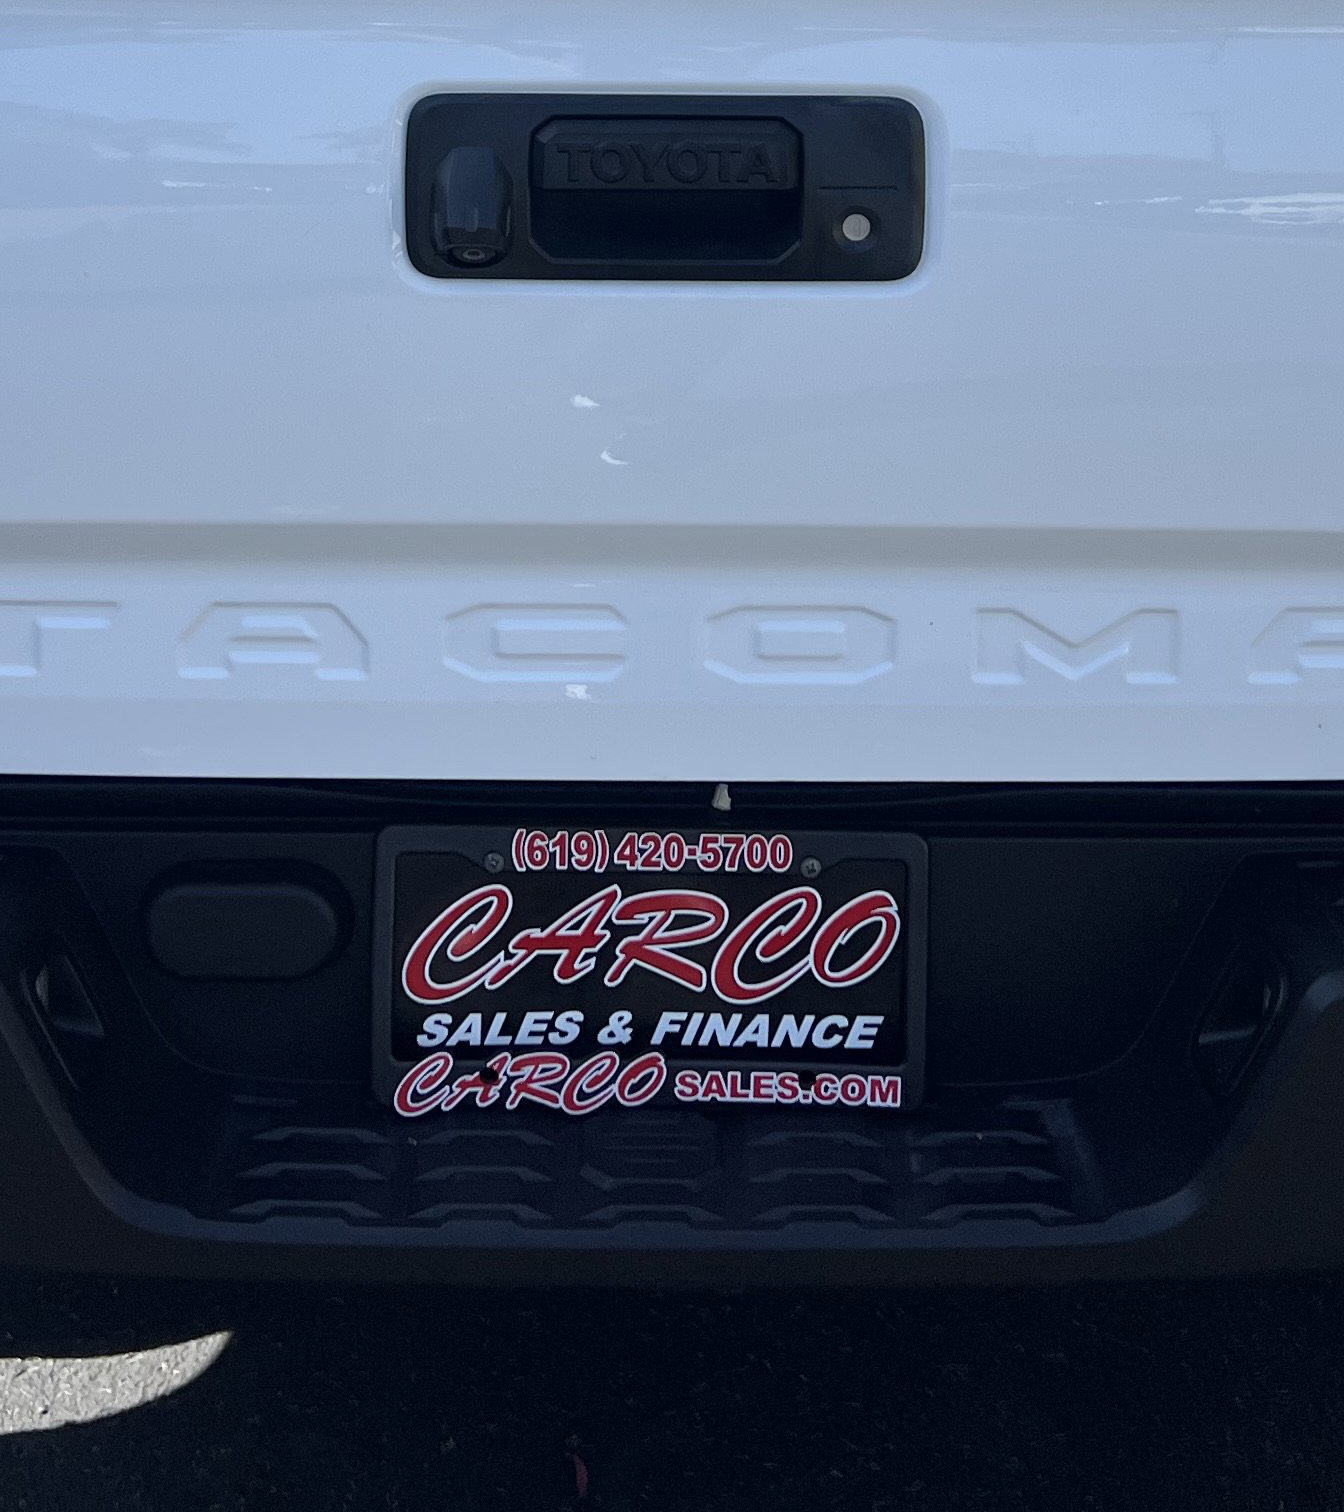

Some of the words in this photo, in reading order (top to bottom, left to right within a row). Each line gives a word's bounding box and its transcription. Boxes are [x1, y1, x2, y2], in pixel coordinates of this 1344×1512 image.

[556, 141, 779, 184] TOYOTA
[511, 829, 610, 872] (619)
[615, 833, 794, 872] 420-5700
[401, 883, 901, 1005] CARCO
[416, 1011, 585, 1047] SALES
[597, 1009, 635, 1045] &
[650, 1014, 884, 1050] FINANCE
[394, 1050, 667, 1117] CARCO
[674, 1070, 902, 1107] SALES.COM
